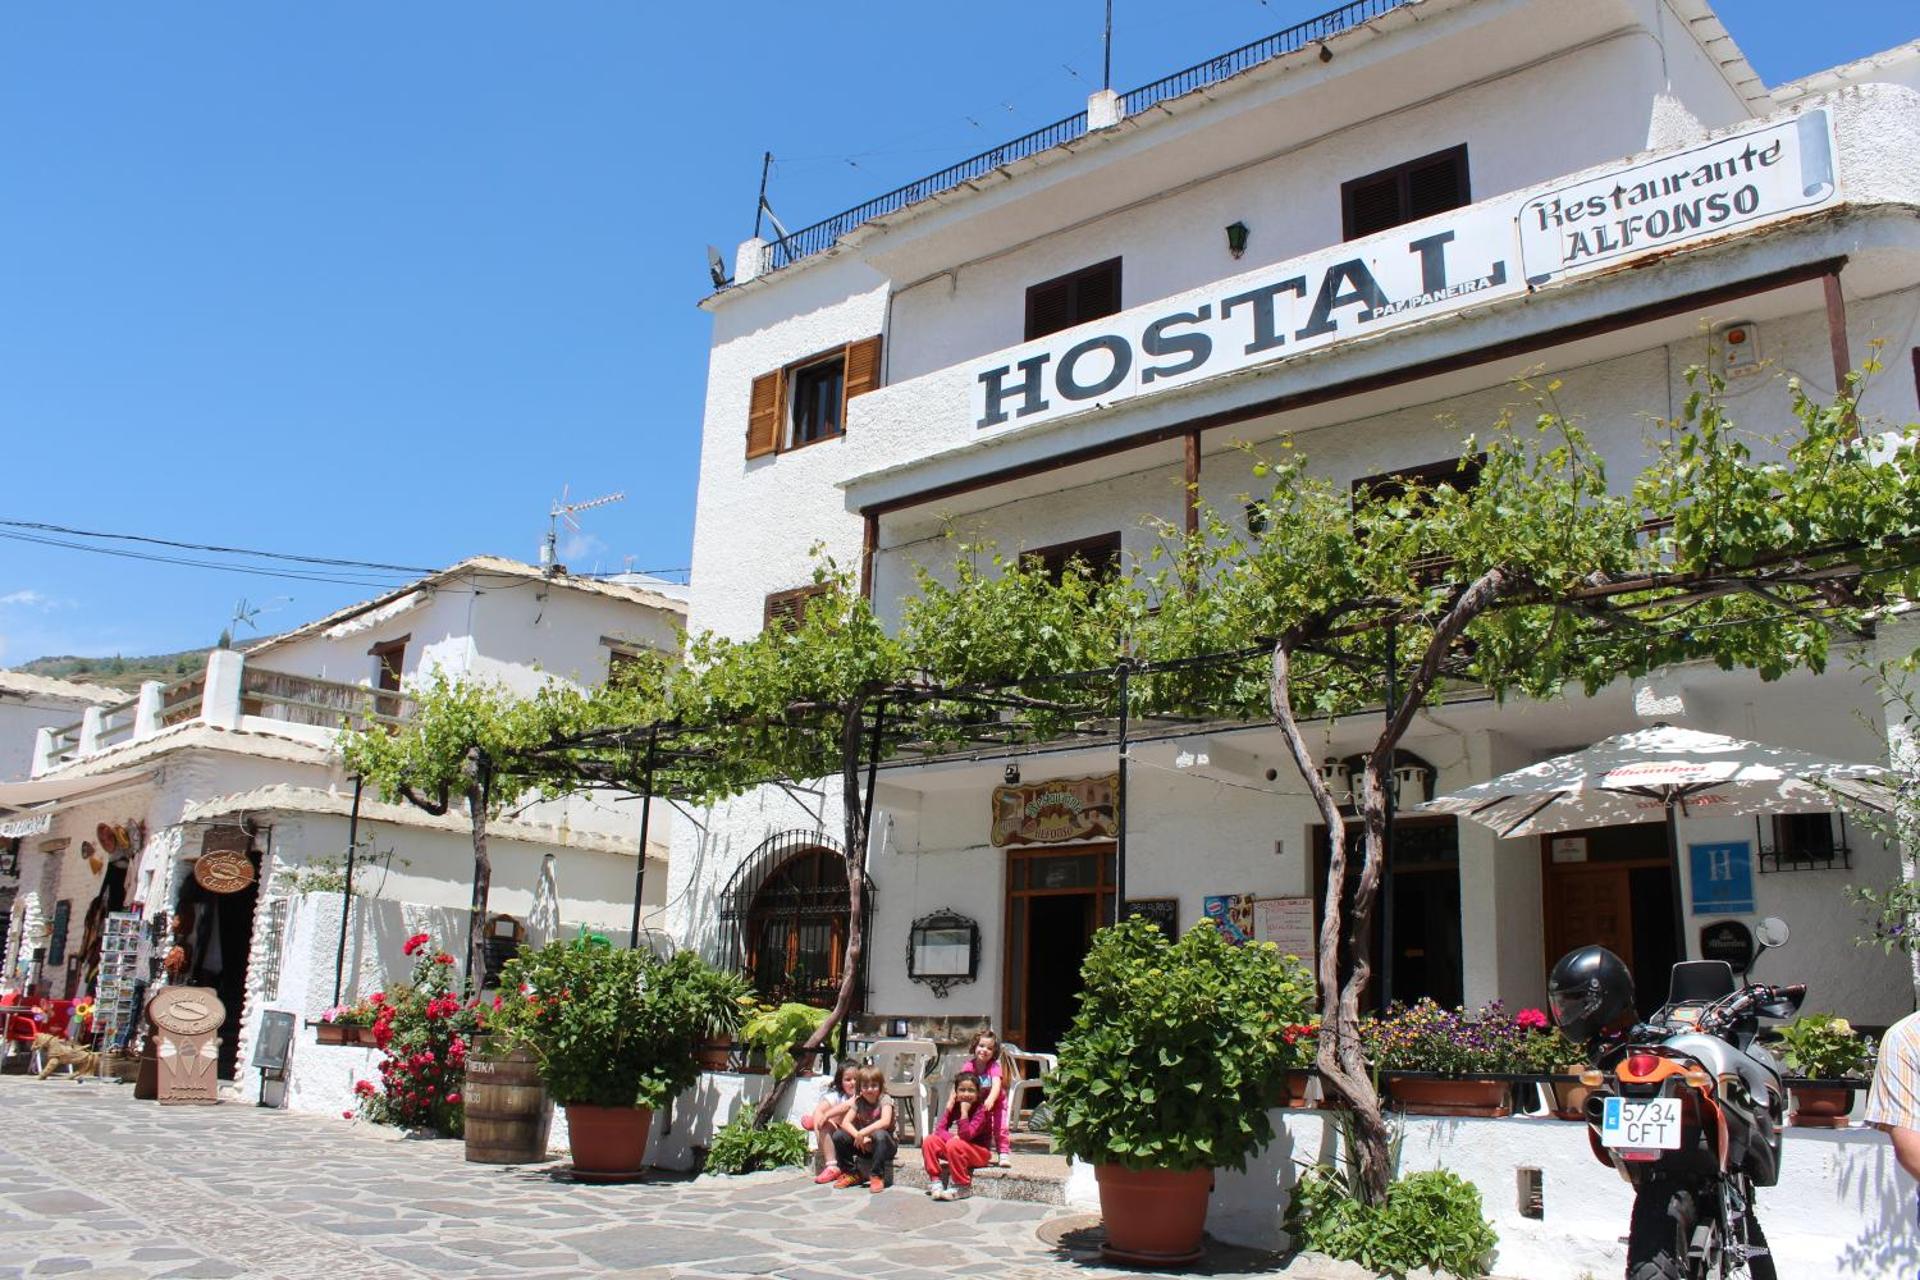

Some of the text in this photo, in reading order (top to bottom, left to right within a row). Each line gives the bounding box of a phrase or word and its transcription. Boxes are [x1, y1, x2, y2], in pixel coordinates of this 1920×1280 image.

[1530, 138, 1781, 232] Restaurante
[1562, 183, 1760, 264] ALFONSO
[1371, 275, 1492, 319] PAMPANEIRA
[976, 229, 1507, 430] HOSTAL
[1622, 1102, 1676, 1123] 5734
[1627, 1123, 1668, 1144] CFT
